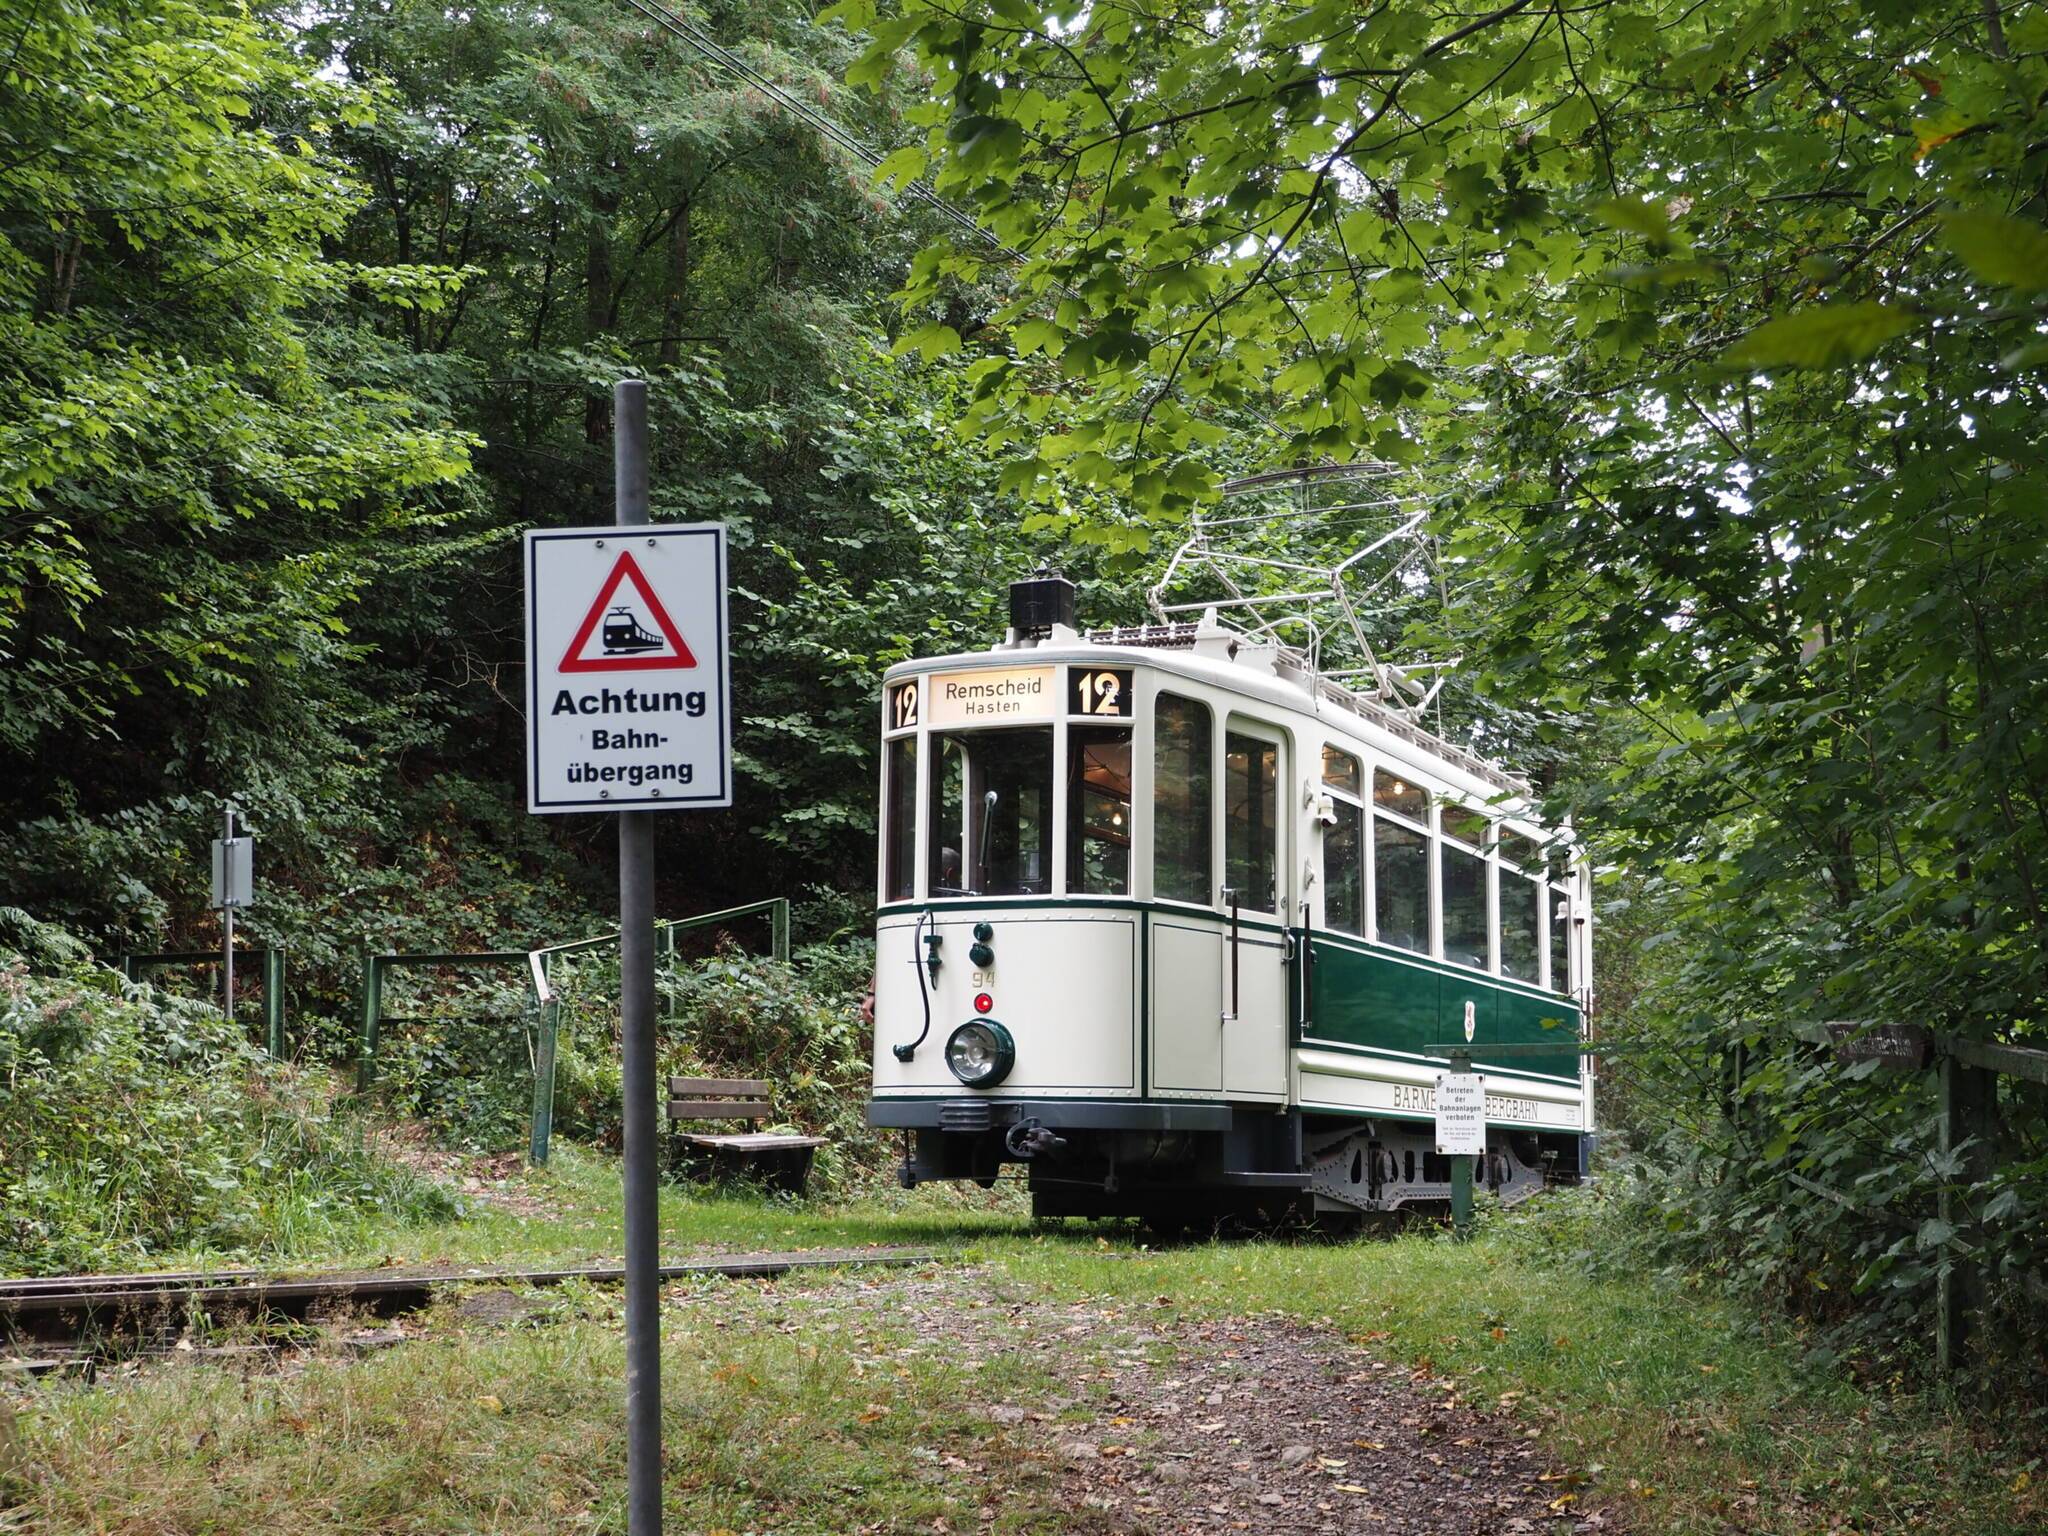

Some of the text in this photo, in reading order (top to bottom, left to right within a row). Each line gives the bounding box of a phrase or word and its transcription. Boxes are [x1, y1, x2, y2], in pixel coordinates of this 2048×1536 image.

[946, 677, 1041, 700] Remscheid
[1079, 672, 1120, 714] 12
[551, 688, 706, 717] Achtung
[895, 684, 917, 728] 12
[966, 700, 1020, 715] Hasten
[592, 729, 668, 750] Bahn-
[567, 762, 693, 785] übergang
[972, 971, 995, 988] 94
[1394, 1086, 1436, 1110] BARME
[1485, 1097, 1538, 1120] BERGBAHN
[1440, 1105, 1482, 1113] Bahnanlagen
